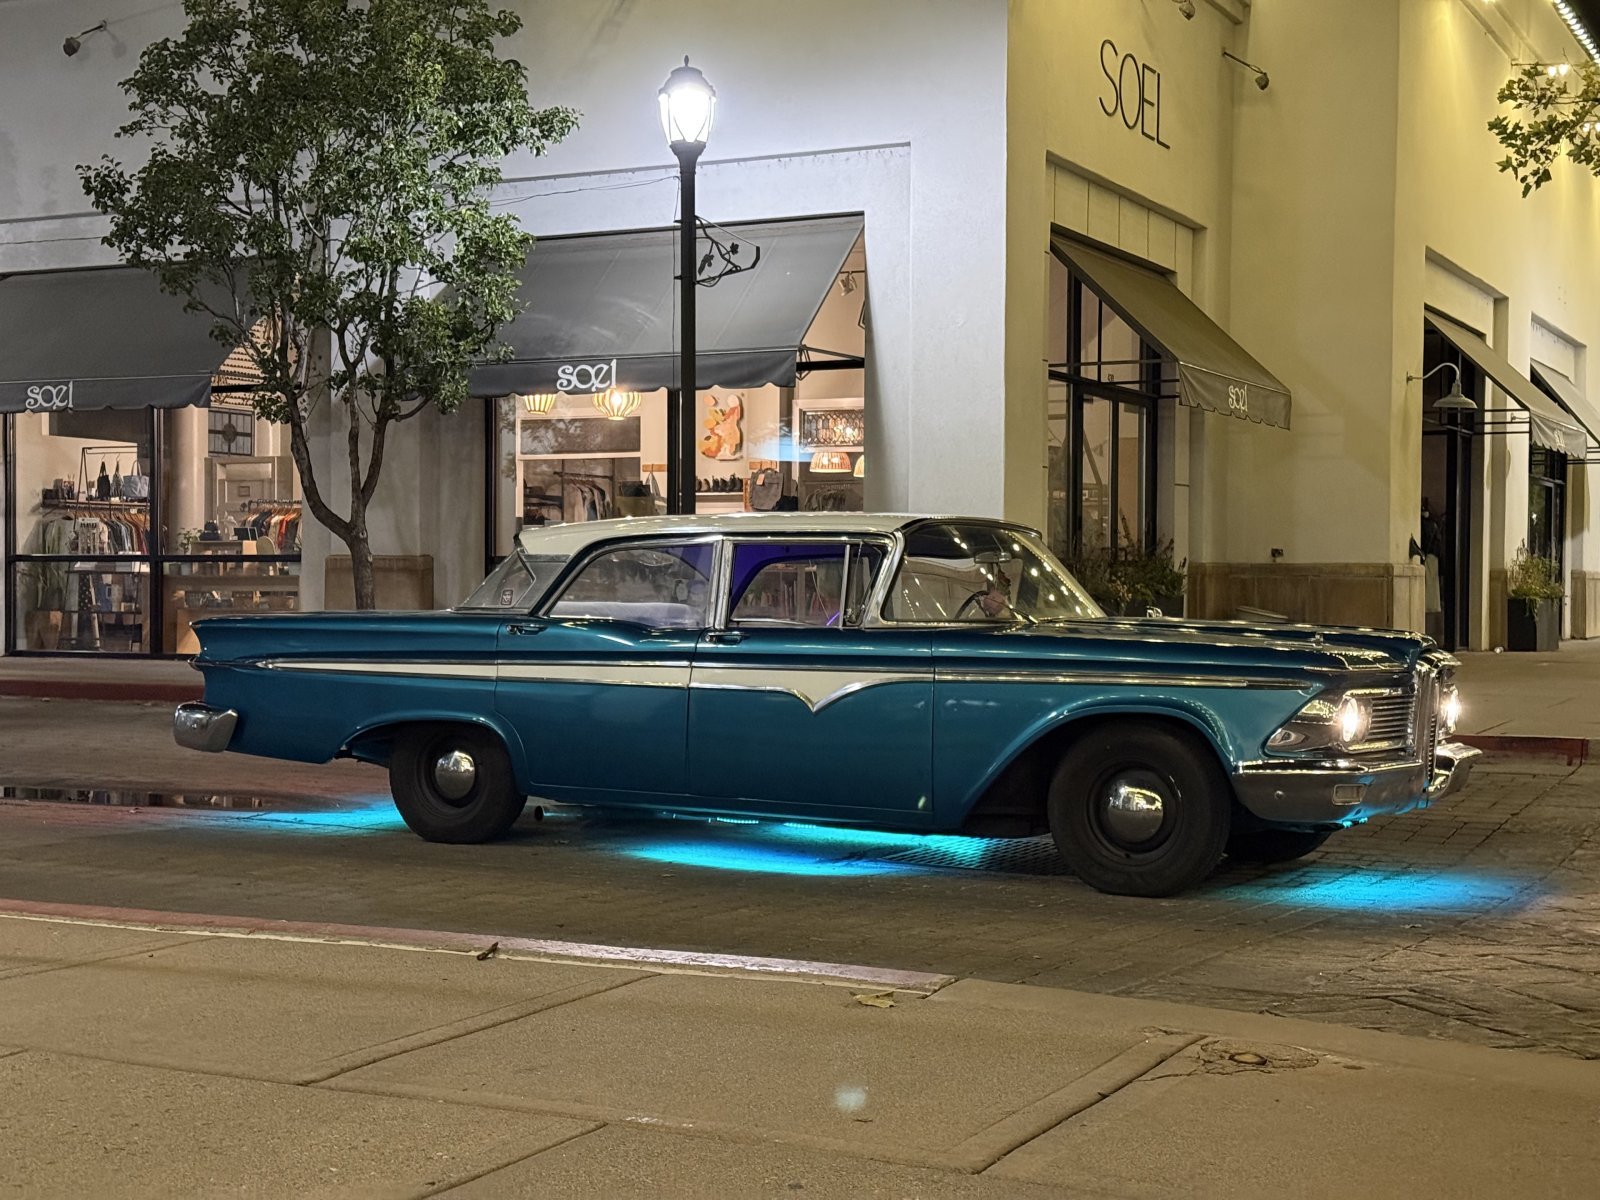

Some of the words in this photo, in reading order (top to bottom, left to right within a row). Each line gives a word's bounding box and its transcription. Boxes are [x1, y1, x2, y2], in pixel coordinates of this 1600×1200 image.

[1099, 39, 1171, 150] SOEL
[556, 358, 617, 392] soel
[25, 380, 74, 410] soel
